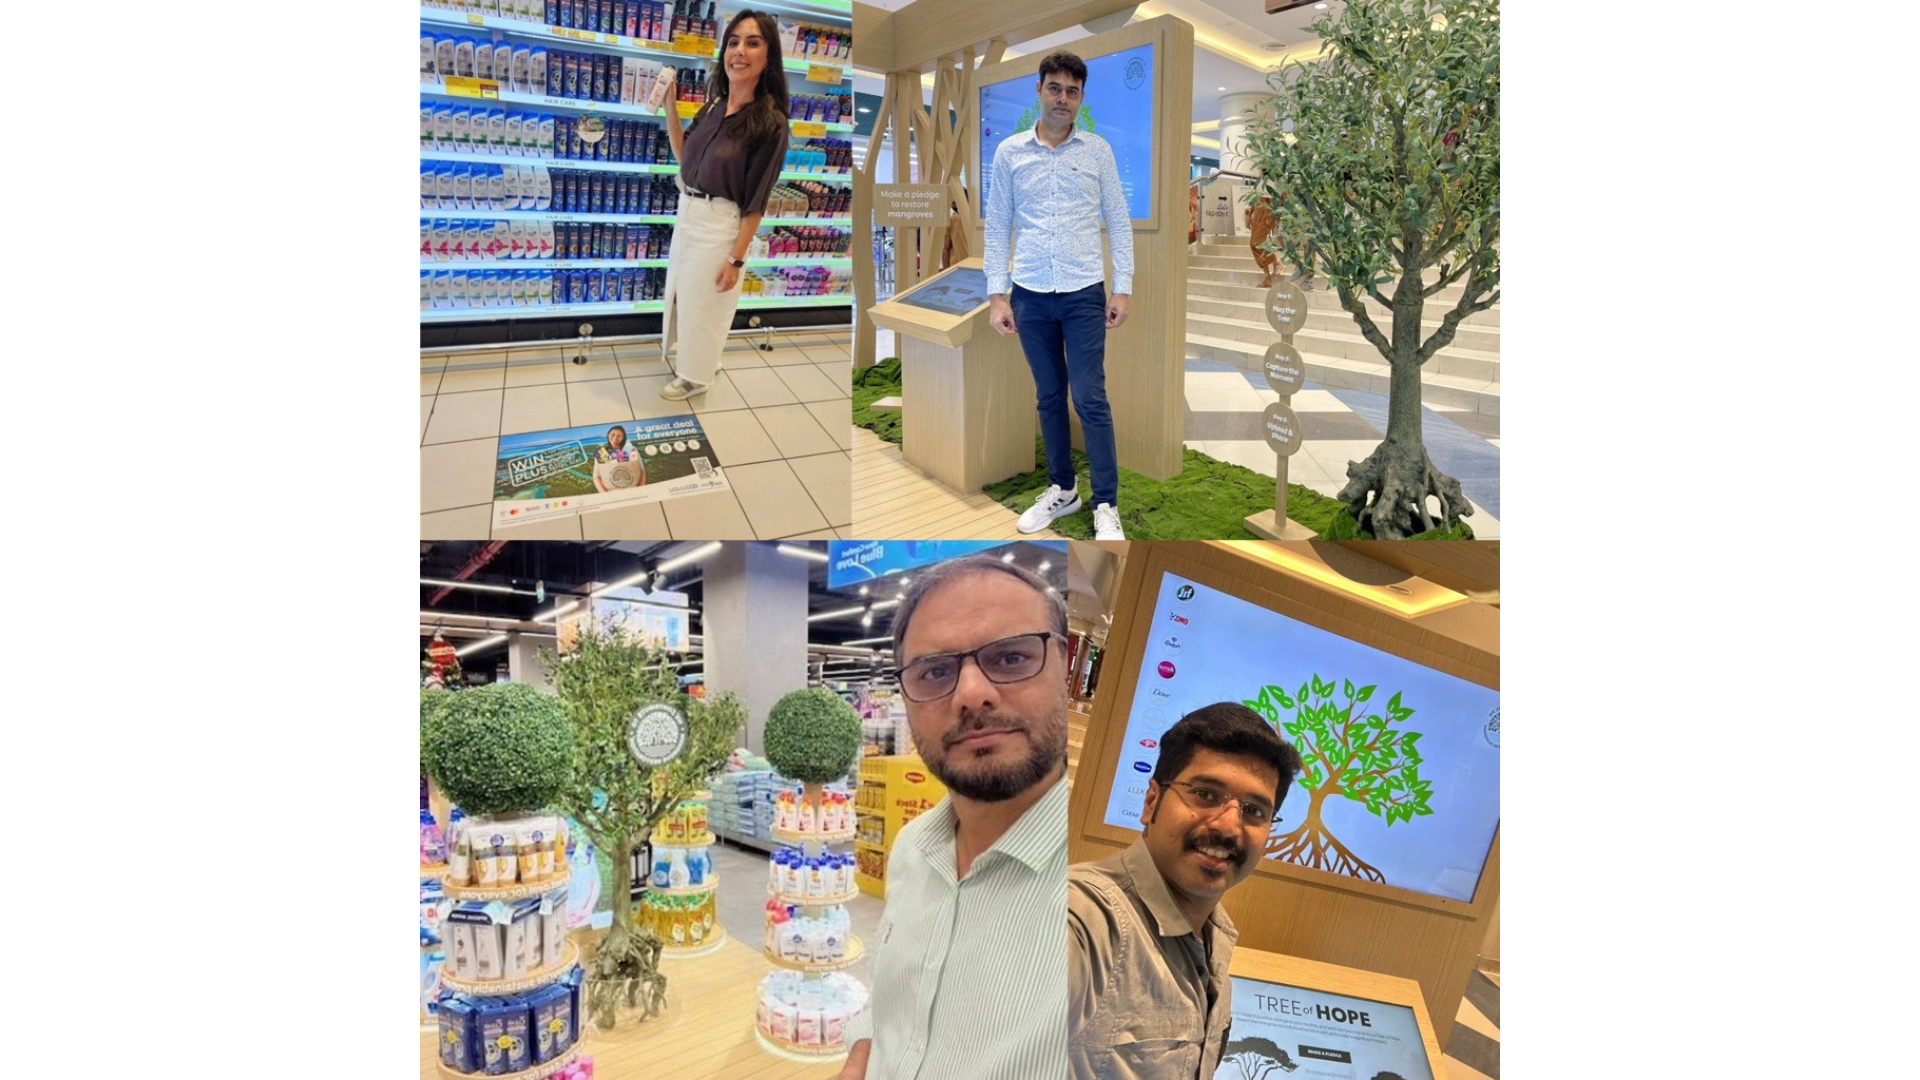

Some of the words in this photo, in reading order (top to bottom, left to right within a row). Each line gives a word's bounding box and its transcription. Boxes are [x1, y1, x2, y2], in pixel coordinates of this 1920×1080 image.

[911, 191, 940, 199] pledge
[888, 211, 934, 219] mangroves
[1272, 306, 1285, 315] Hug
[1266, 362, 1288, 372] Capture
[1289, 368, 1299, 376] the
[1270, 372, 1294, 383] Moment
[645, 423, 671, 432] great
[673, 420, 694, 428] deal
[1267, 422, 1287, 435] Upload
[654, 427, 698, 438] everyone
[1272, 432, 1288, 443] Share
[512, 454, 545, 471] WIN
[515, 465, 548, 483] PLUS
[1153, 689, 1170, 698] Dove
[1128, 786, 1145, 795] LUX
[1122, 809, 1139, 818] CLEAR
[1254, 994, 1302, 1016] TREE
[1303, 1006, 1313, 1015] of
[1316, 1004, 1372, 1027] HOPE
